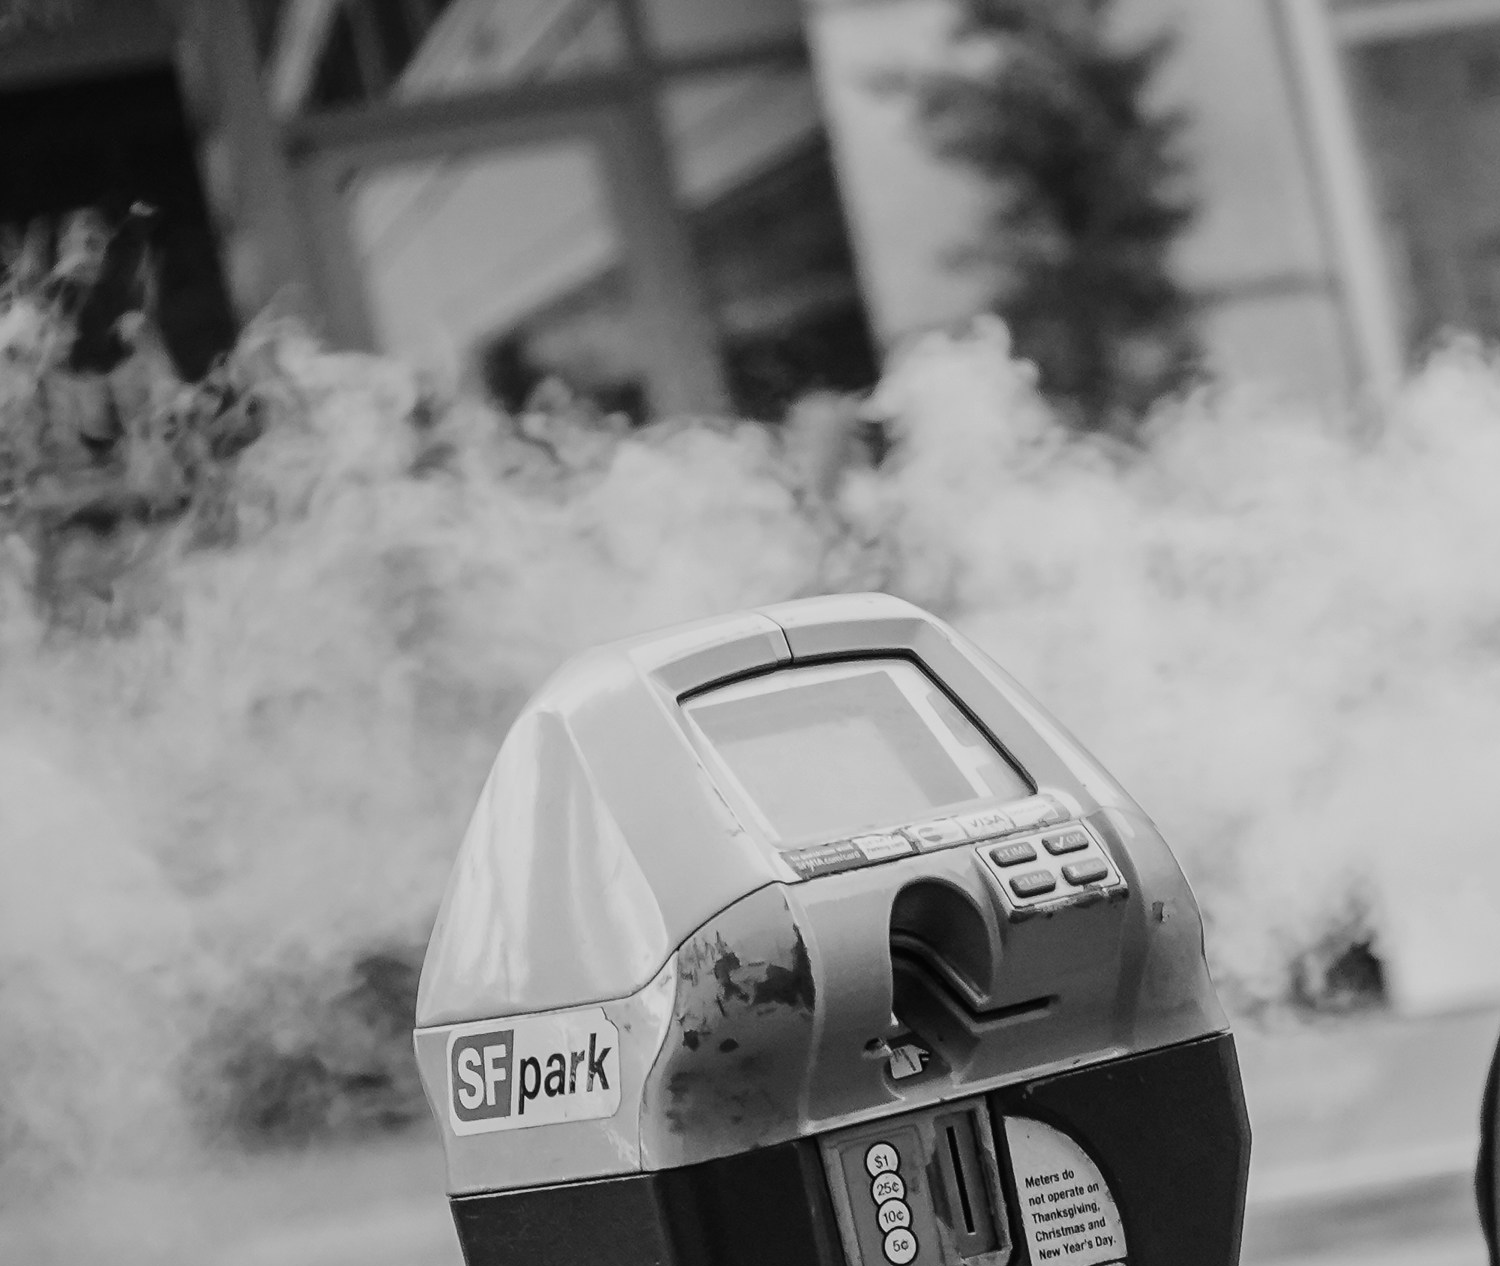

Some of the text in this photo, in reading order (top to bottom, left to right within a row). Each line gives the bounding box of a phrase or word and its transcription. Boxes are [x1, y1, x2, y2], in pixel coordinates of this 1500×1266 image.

[971, 814, 1003, 828] VISA
[874, 1154, 888, 1169] $1
[1025, 1169, 1074, 1188] Meters do
[877, 1182, 899, 1196] 25¢
[1028, 1182, 1099, 1206] not operate on
[883, 1211, 904, 1223] 10¢
[1031, 1202, 1100, 1223] Thanksgiving,
[1035, 1216, 1106, 1242] Christmas and
[893, 1240, 909, 1252] 5¢
[1039, 1235, 1116, 1260] New Year's Day.
